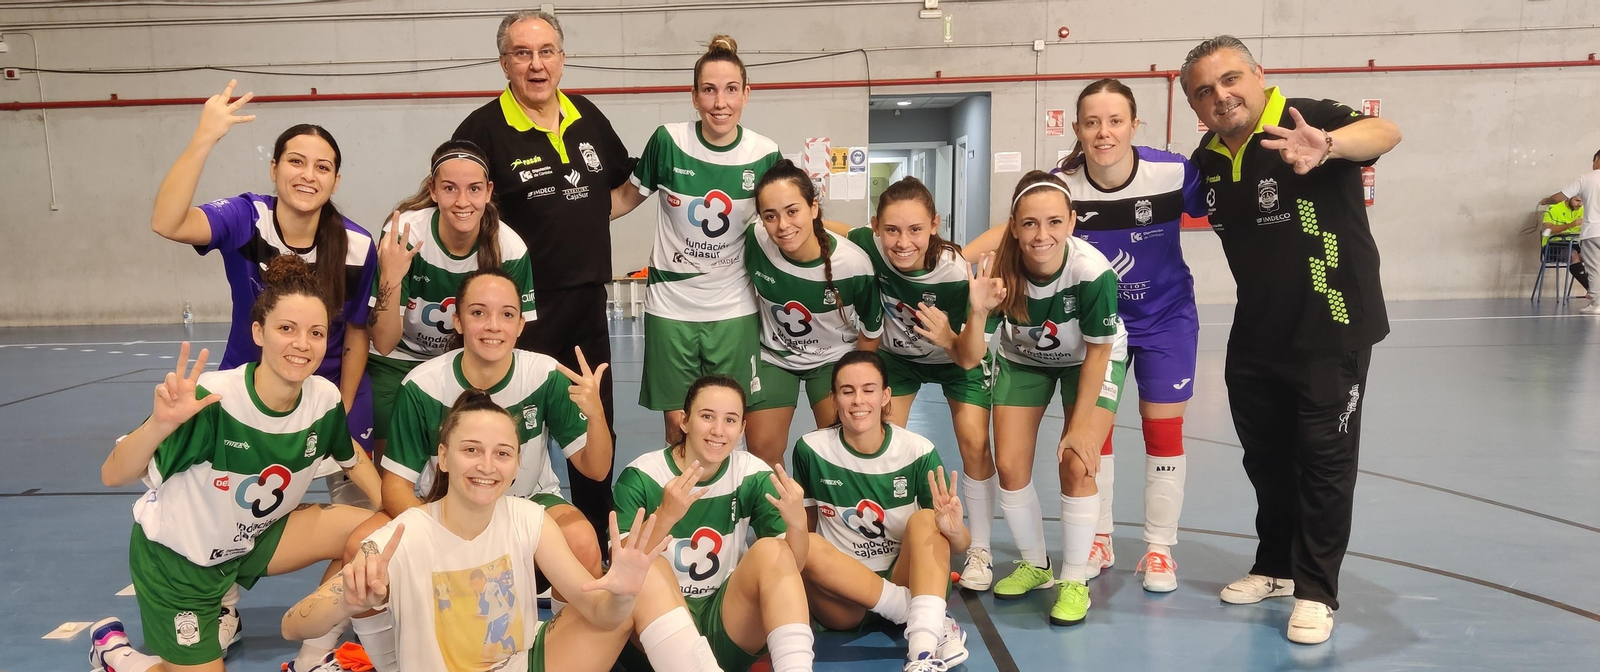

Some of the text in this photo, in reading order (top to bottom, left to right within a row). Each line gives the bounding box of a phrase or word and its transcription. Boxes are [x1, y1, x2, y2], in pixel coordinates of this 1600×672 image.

[533, 186, 555, 196] IMDECO
[1263, 213, 1291, 222] IMDECO
[684, 247, 720, 259] cajasur
[1117, 290, 1147, 301] aSur
[854, 546, 895, 559] cajasur
